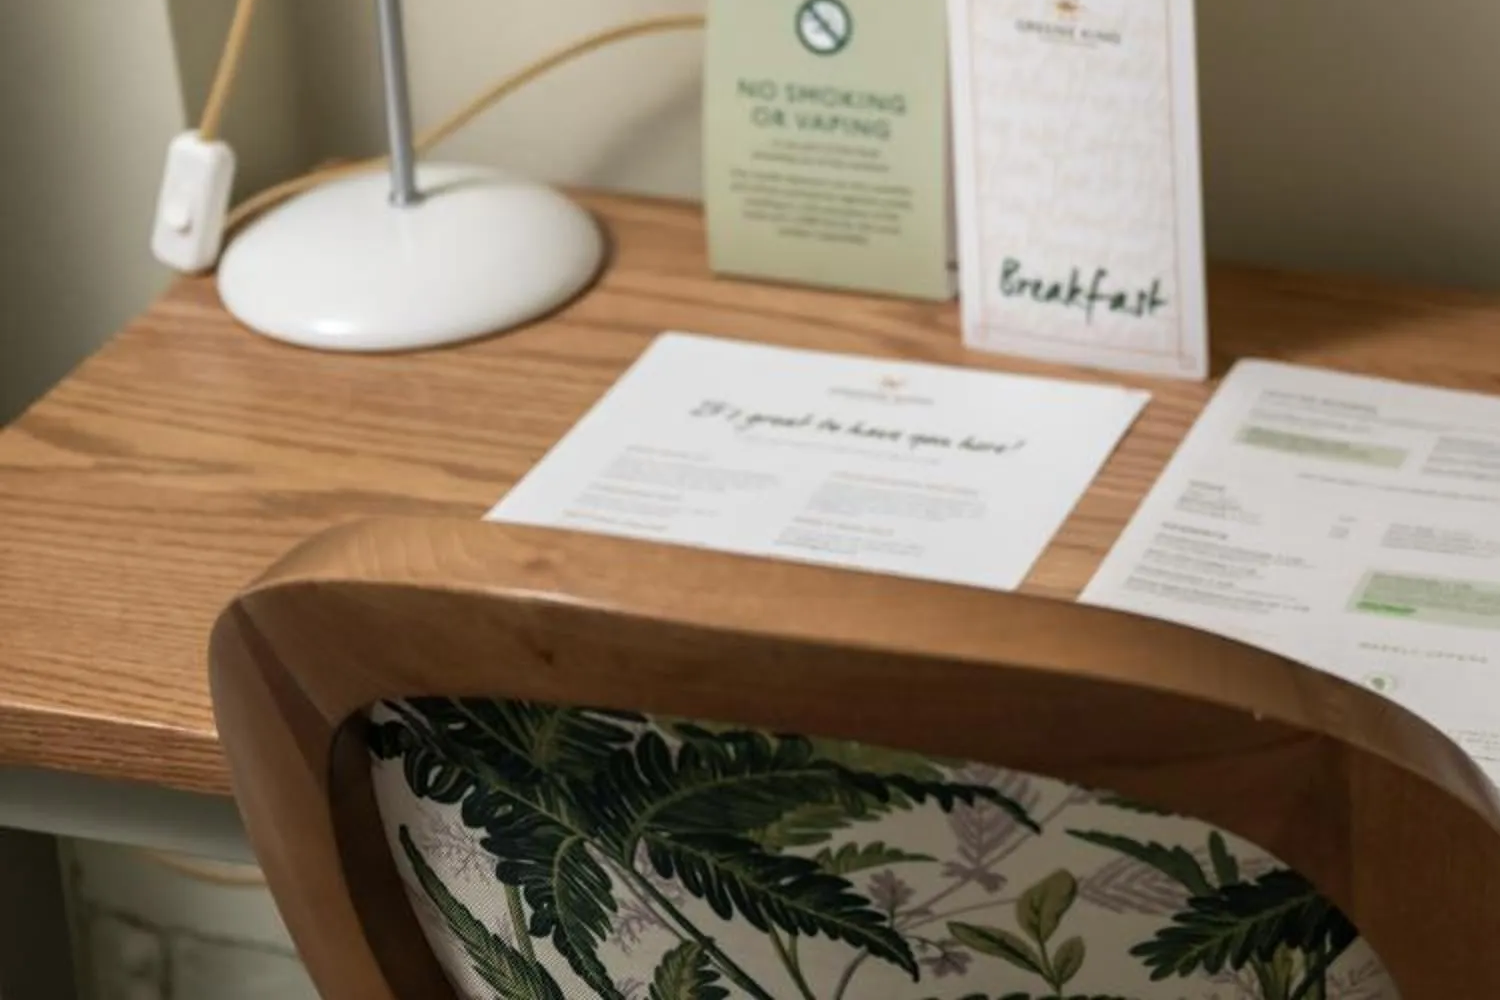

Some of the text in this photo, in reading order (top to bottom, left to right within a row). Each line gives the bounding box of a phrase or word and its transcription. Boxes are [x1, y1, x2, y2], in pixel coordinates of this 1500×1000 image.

[736, 77, 908, 116] NO SMOKING
[751, 104, 892, 141] OR VAPING
[999, 256, 1168, 326] Breakfast
